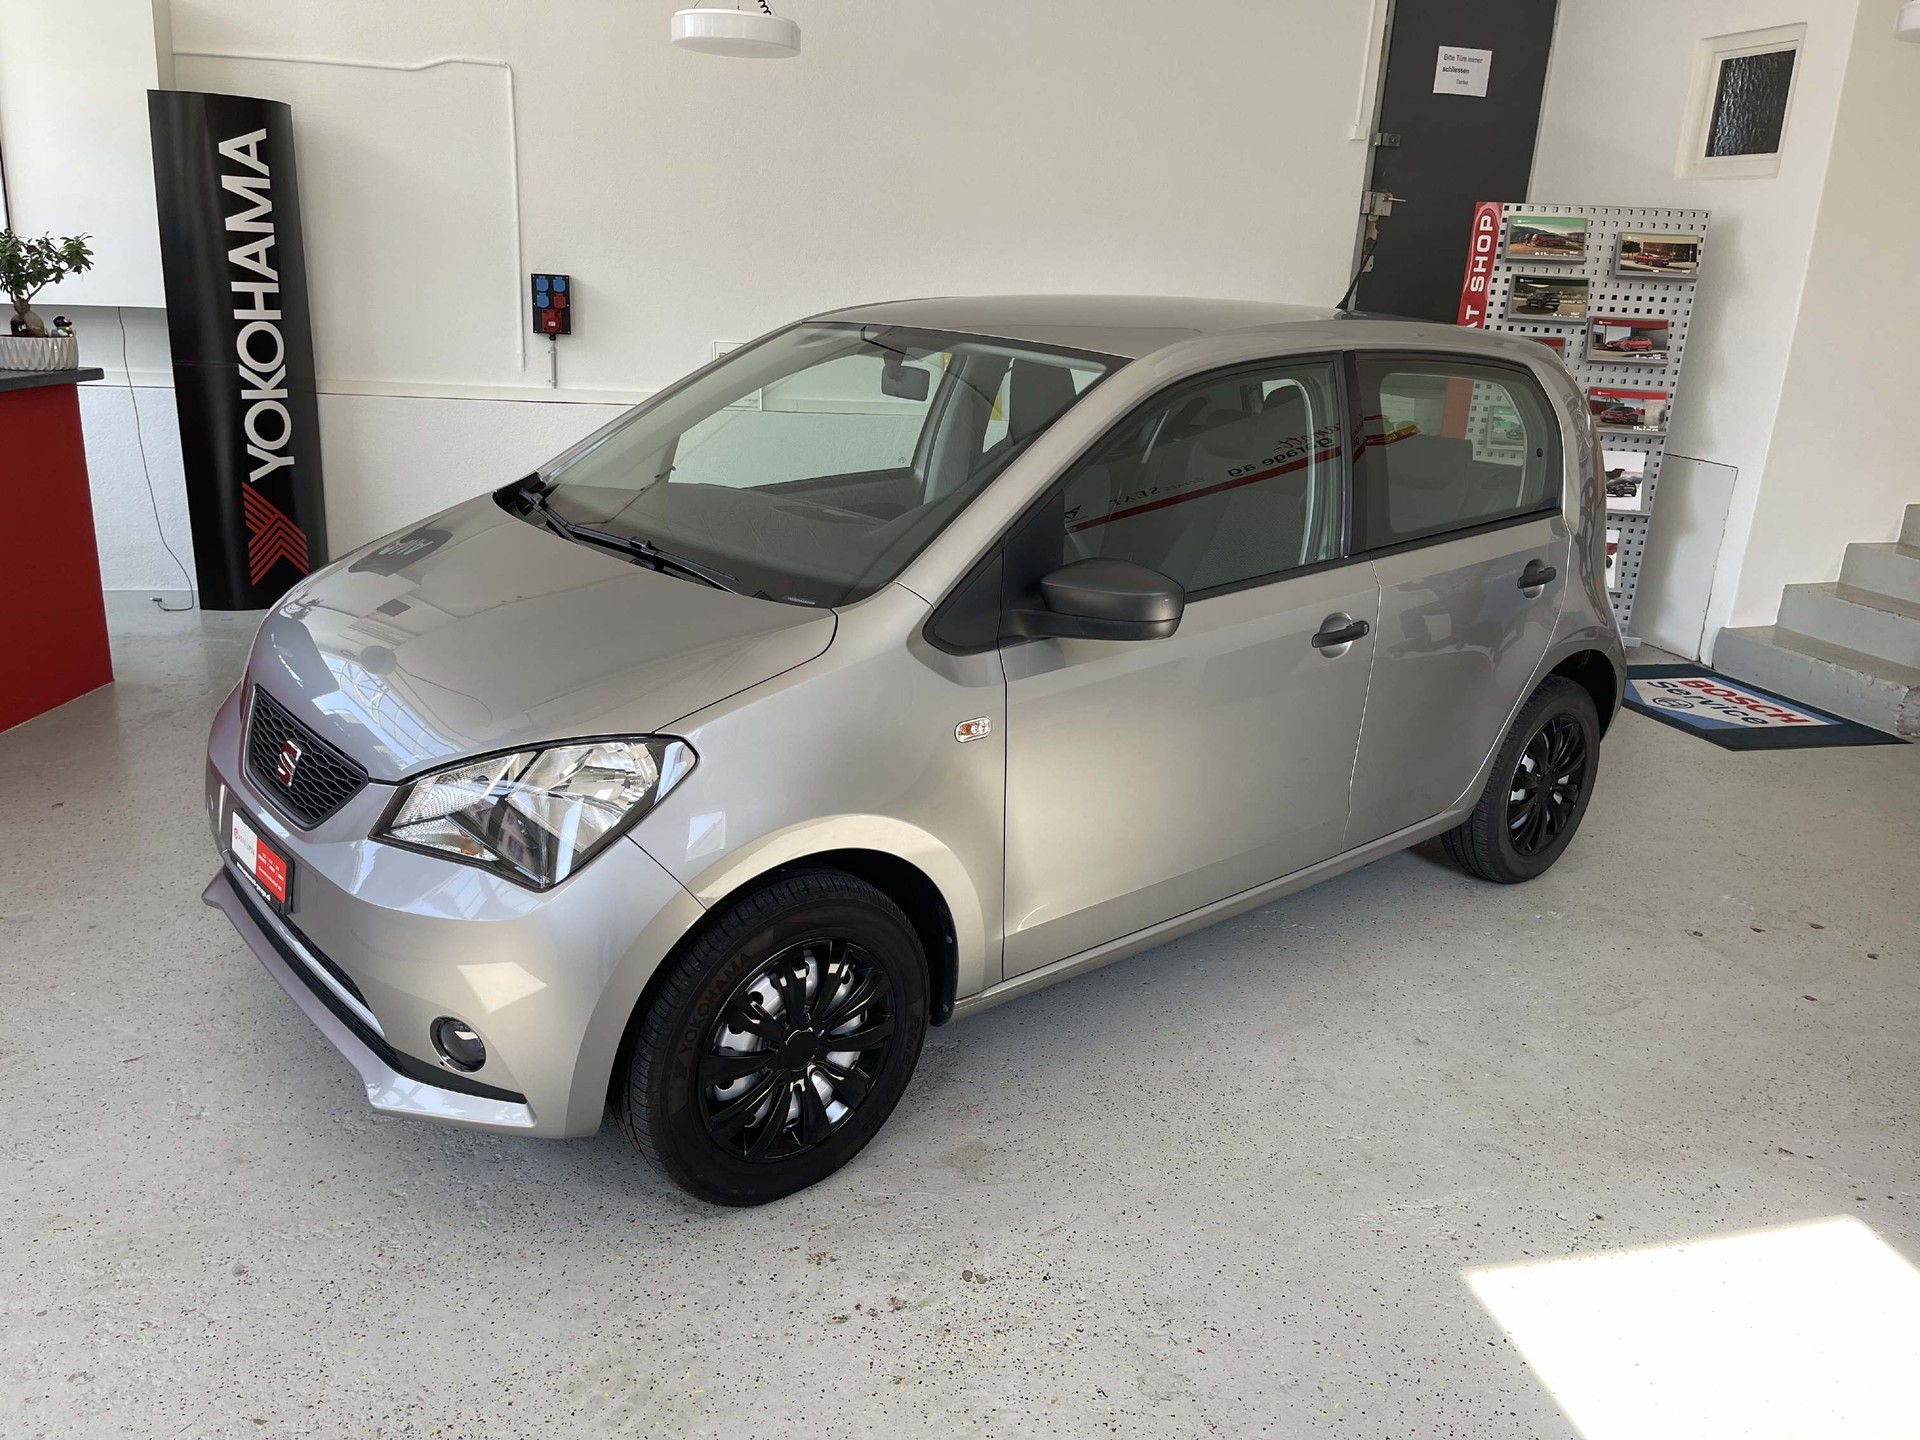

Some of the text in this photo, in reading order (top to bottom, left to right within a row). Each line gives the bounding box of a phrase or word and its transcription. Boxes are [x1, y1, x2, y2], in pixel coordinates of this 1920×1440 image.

[1442, 66, 1470, 74] schliessen
[1469, 215, 1493, 292] SHOP
[218, 128, 295, 482] YOKOHAMA
[1647, 680, 1769, 725] Service
[1678, 680, 1811, 724] BOSCH
[679, 952, 754, 1055] YOKOHAMA
